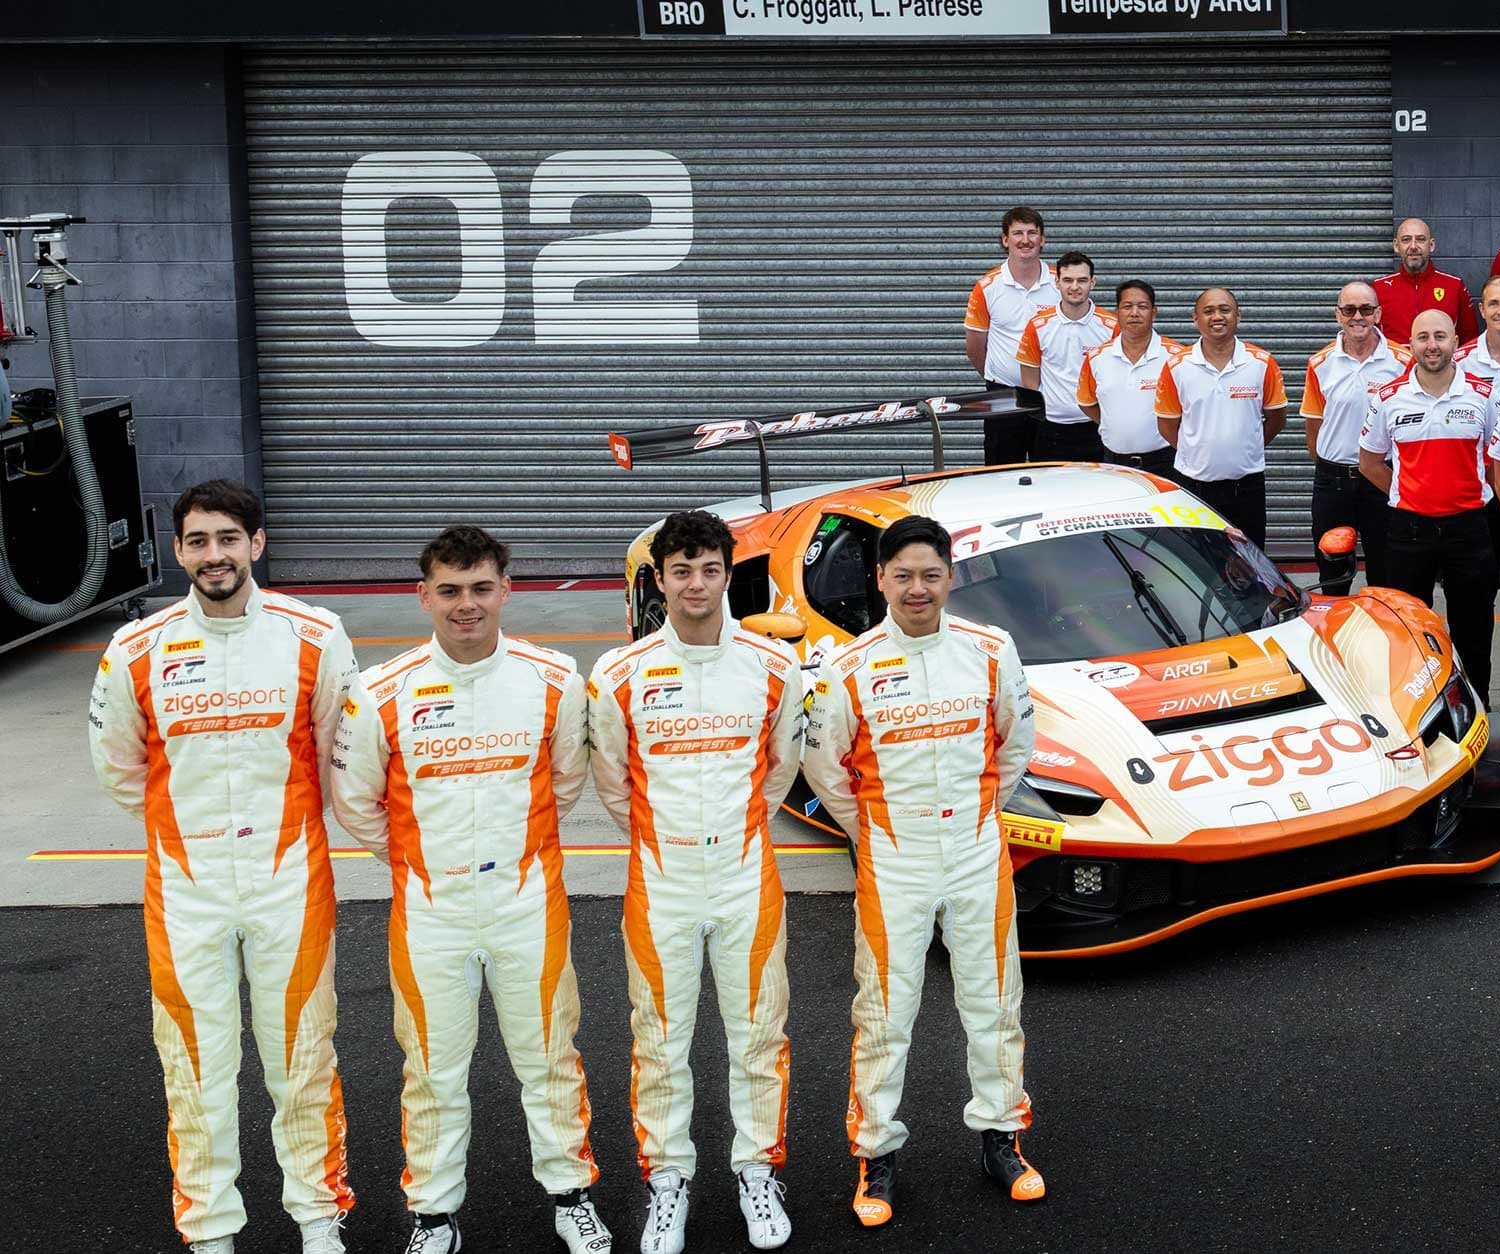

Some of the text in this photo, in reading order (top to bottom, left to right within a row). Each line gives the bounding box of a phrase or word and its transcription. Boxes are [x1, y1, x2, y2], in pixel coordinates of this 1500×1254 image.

[660, 1, 705, 25] BRO
[763, 0, 865, 25] Froggatt,
[899, 0, 984, 18] Patrese
[1059, 0, 1168, 19] Tempesta
[1175, 0, 1199, 19] by
[1395, 109, 1427, 132] 02
[341, 150, 699, 347] 02
[1395, 412, 1425, 426] LEE
[1448, 409, 1476, 417] ARISE
[1036, 511, 1151, 529] INTERCONTINENTAL
[1039, 517, 1156, 536] GT CHALLENGE
[300, 623, 324, 640] OMP
[128, 636, 151, 655] OMP
[979, 639, 999, 652] OMP
[766, 657, 788, 672] OMP
[840, 655, 860, 672] OMP
[1161, 659, 1211, 681] ARGT
[171, 677, 207, 687] CHALLENGE
[544, 670, 566, 682] OMP
[611, 664, 632, 682] OMP
[375, 683, 398, 698] OMP
[880, 691, 912, 701] CHALLENGE
[1157, 681, 1281, 715] PINNACLE
[163, 687, 287, 715] ziggosport
[651, 702, 684, 711] CHALLENGE
[875, 695, 982, 725] ziggosport
[182, 715, 269, 731] TEMPESTA
[421, 721, 456, 731] CHALLENGE
[645, 712, 754, 737] ziggosport
[893, 722, 968, 741] TEMPESTA
[413, 730, 532, 758] ziggosport
[663, 738, 737, 753] TEMPESTA
[1152, 718, 1374, 792] ziggo
[431, 758, 515, 776] TEMPESTA
